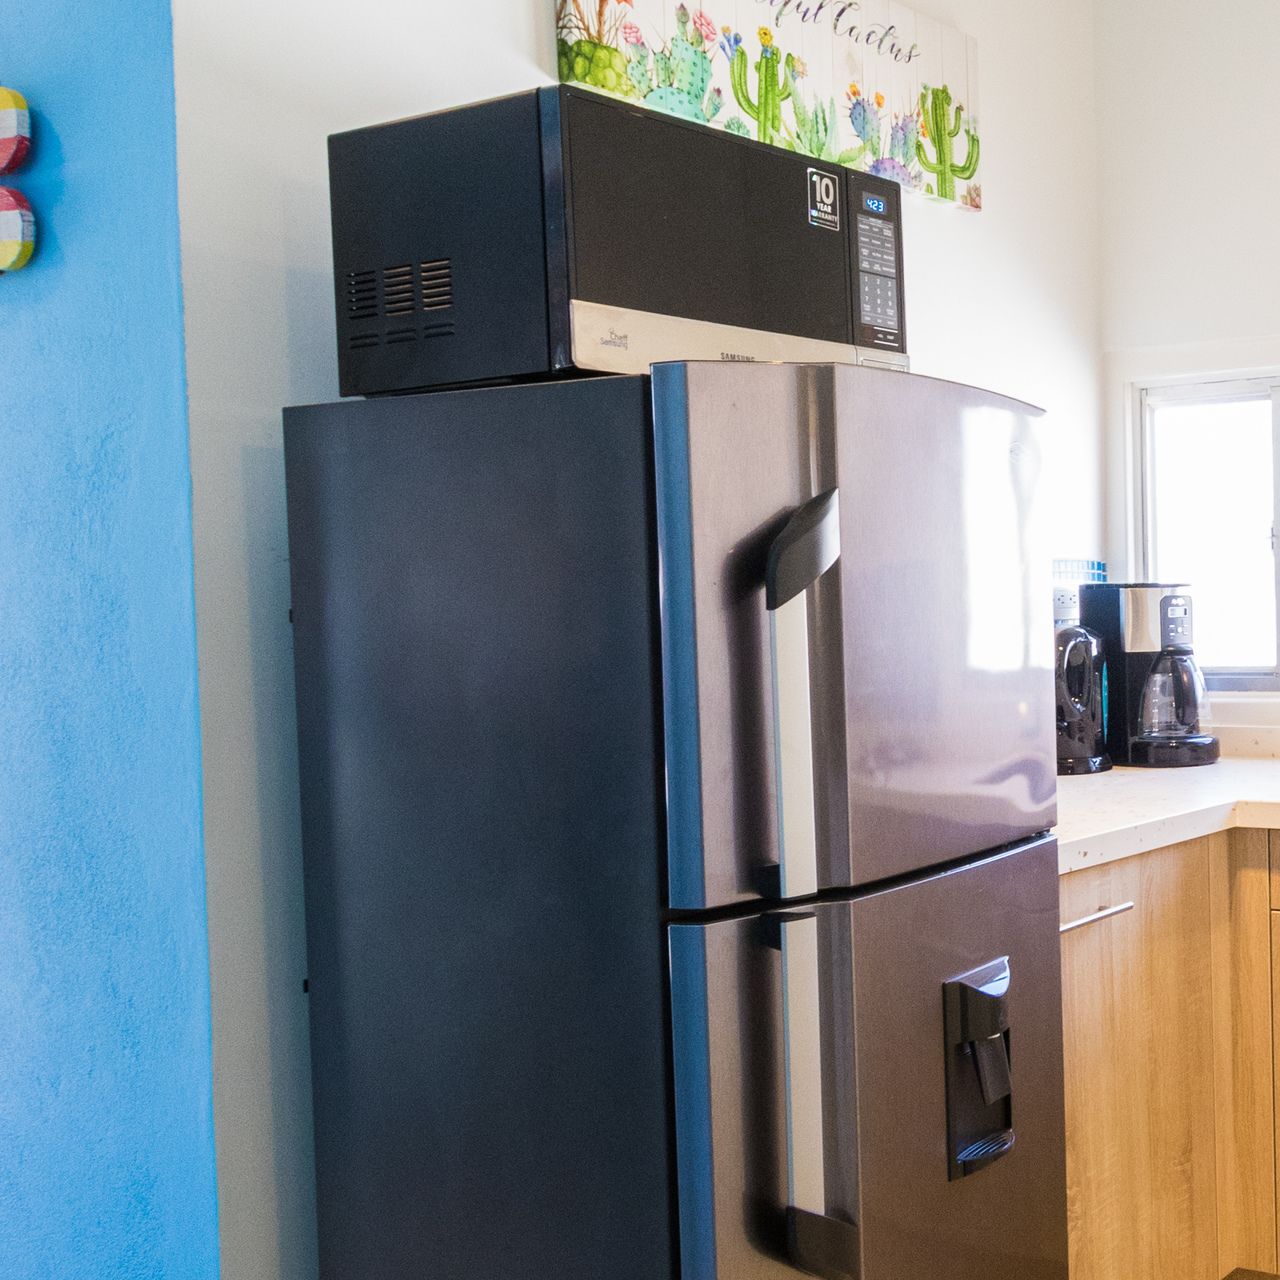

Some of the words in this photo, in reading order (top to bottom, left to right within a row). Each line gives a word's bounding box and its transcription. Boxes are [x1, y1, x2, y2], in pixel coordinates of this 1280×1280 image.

[832, 0, 920, 63] Cactus
[811, 174, 834, 205] 10
[811, 209, 838, 223] ARRANTY
[816, 202, 832, 214] YEAR
